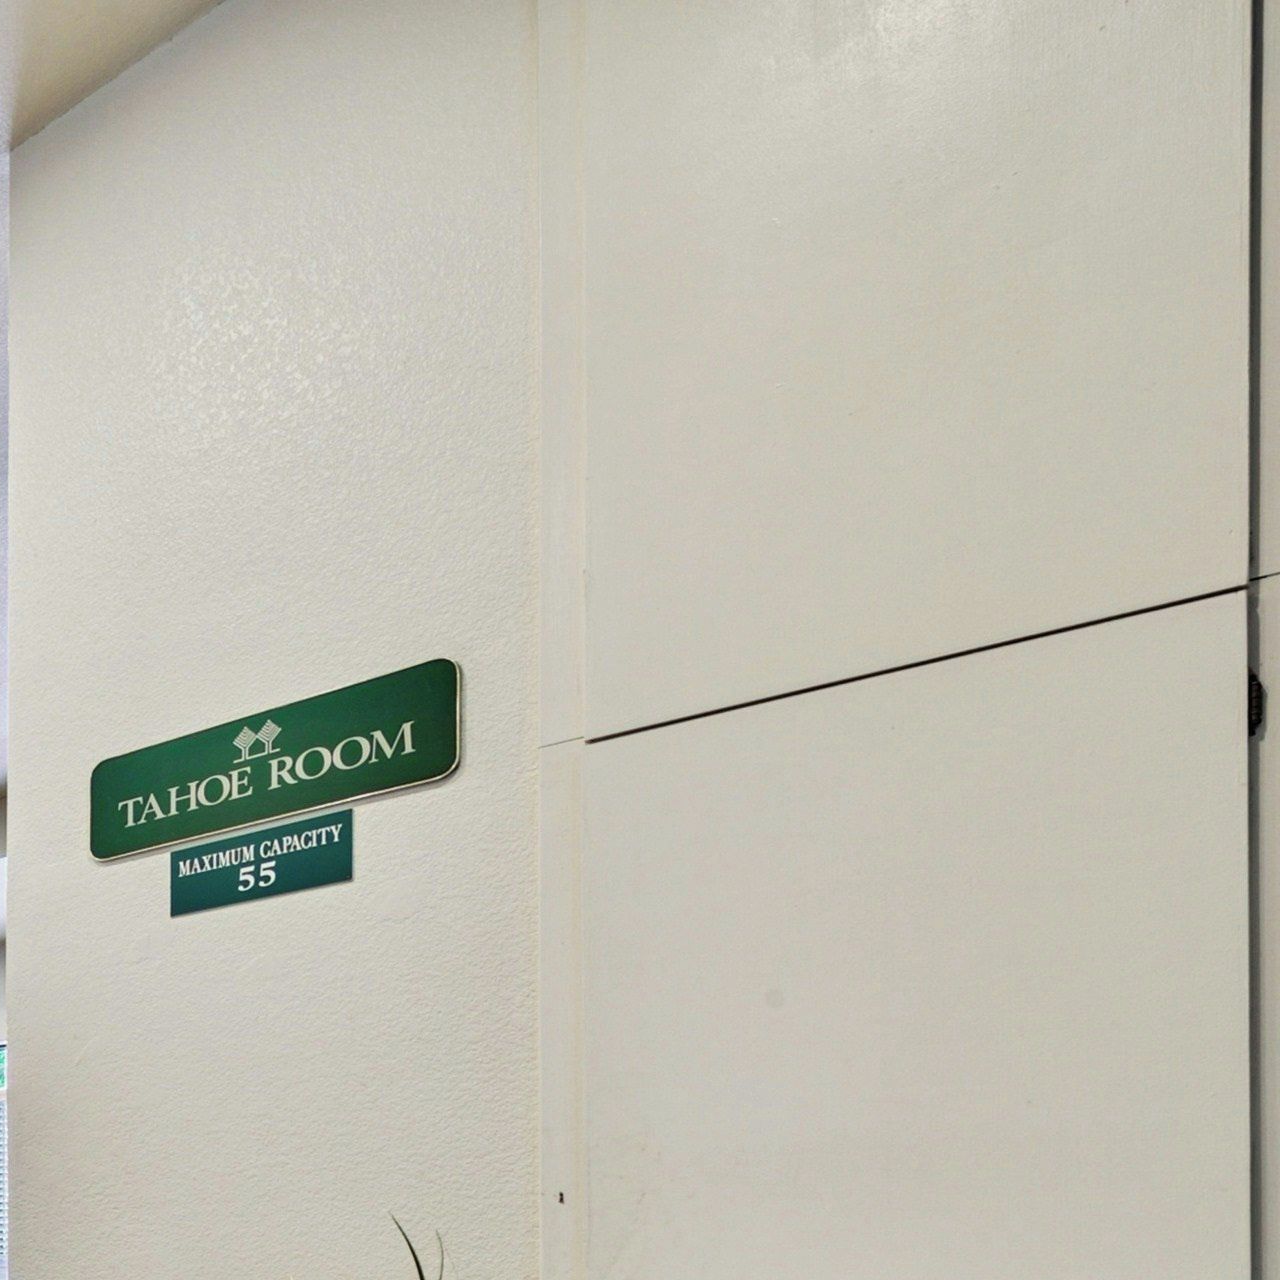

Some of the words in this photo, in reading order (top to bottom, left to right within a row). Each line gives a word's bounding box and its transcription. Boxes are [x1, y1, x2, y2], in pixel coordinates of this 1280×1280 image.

[118, 765, 253, 828] TAHOE
[267, 720, 416, 791] ROOM
[178, 845, 255, 877] MAXIMUM
[259, 823, 343, 859] CAPACITY
[237, 860, 277, 892] 55
